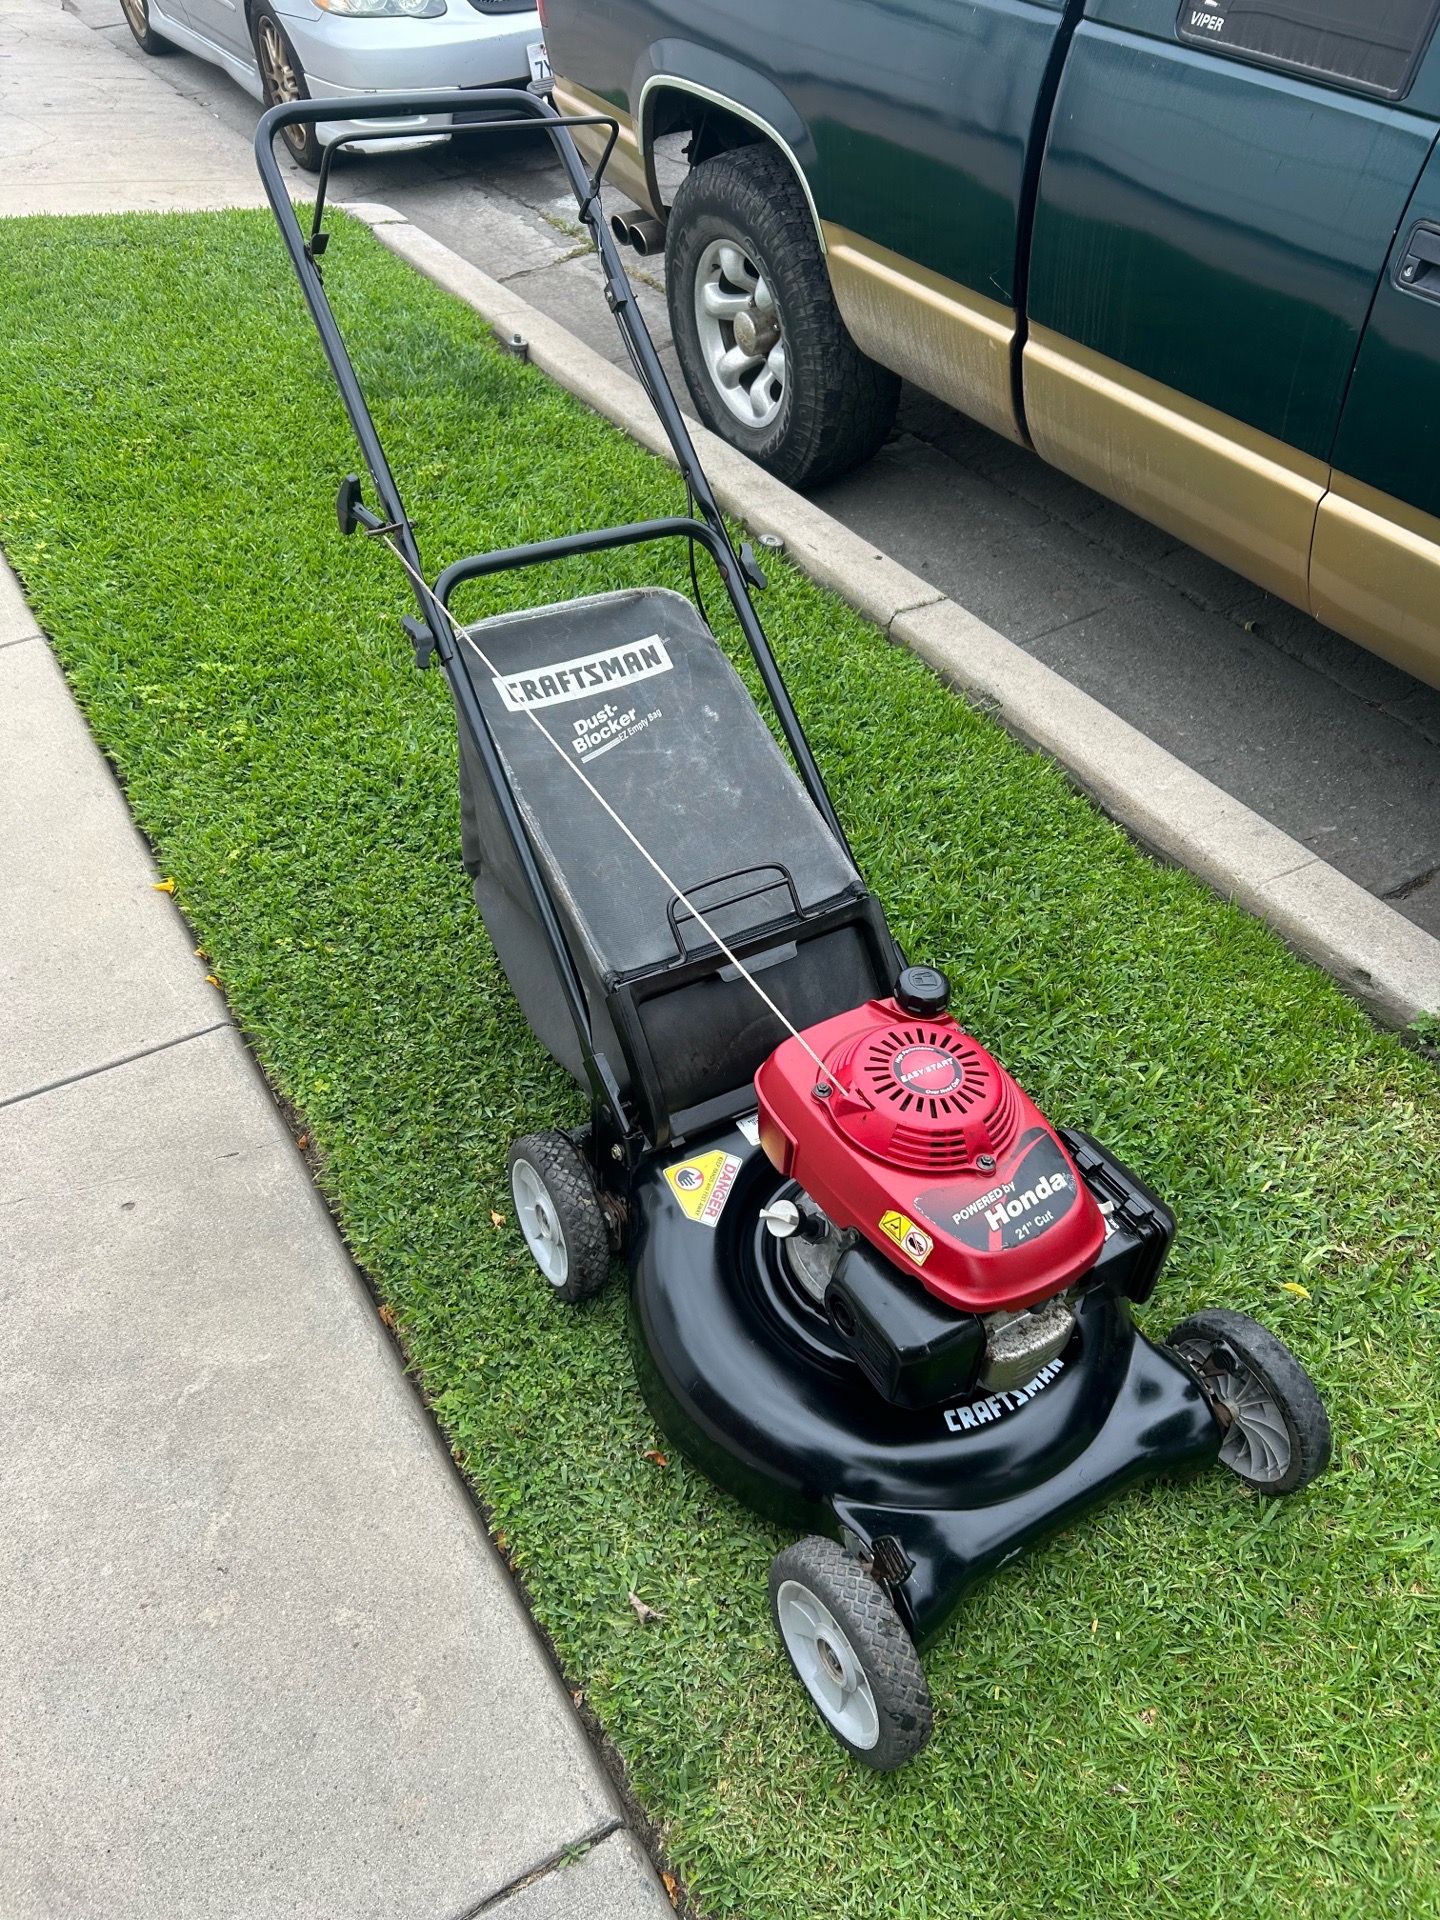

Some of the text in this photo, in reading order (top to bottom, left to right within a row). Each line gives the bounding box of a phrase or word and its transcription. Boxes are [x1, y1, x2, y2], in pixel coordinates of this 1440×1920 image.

[1191, 11, 1225, 31] VIPER
[505, 644, 662, 703] CRAFTSMAN
[571, 707, 636, 754] Blocker
[573, 703, 618, 736] Dust-
[618, 708, 663, 742] EZ Empty Bag
[901, 1058, 953, 1083] EASY START
[705, 1164, 736, 1217] DANGER
[952, 1181, 1016, 1226] POWERED by
[984, 1172, 1068, 1232] Honda
[1014, 1209, 1055, 1241] 21" Cut
[943, 1358, 1065, 1432] CRAFTSMAN
